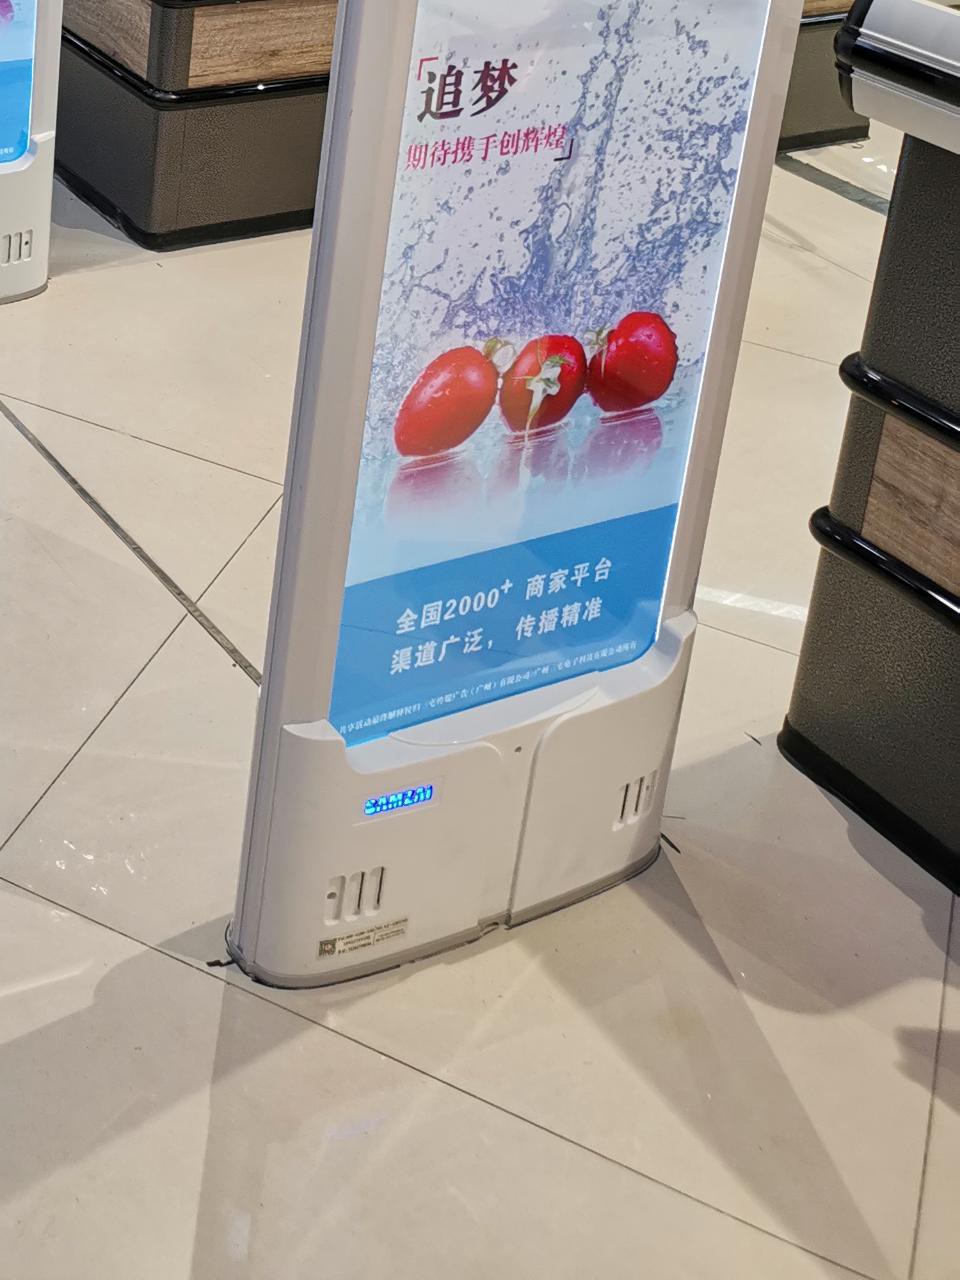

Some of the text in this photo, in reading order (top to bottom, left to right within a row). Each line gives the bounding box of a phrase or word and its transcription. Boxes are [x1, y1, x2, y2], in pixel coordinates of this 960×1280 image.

[525, 557, 613, 600] 商家平台
[515, 596, 603, 641] 传播精准
